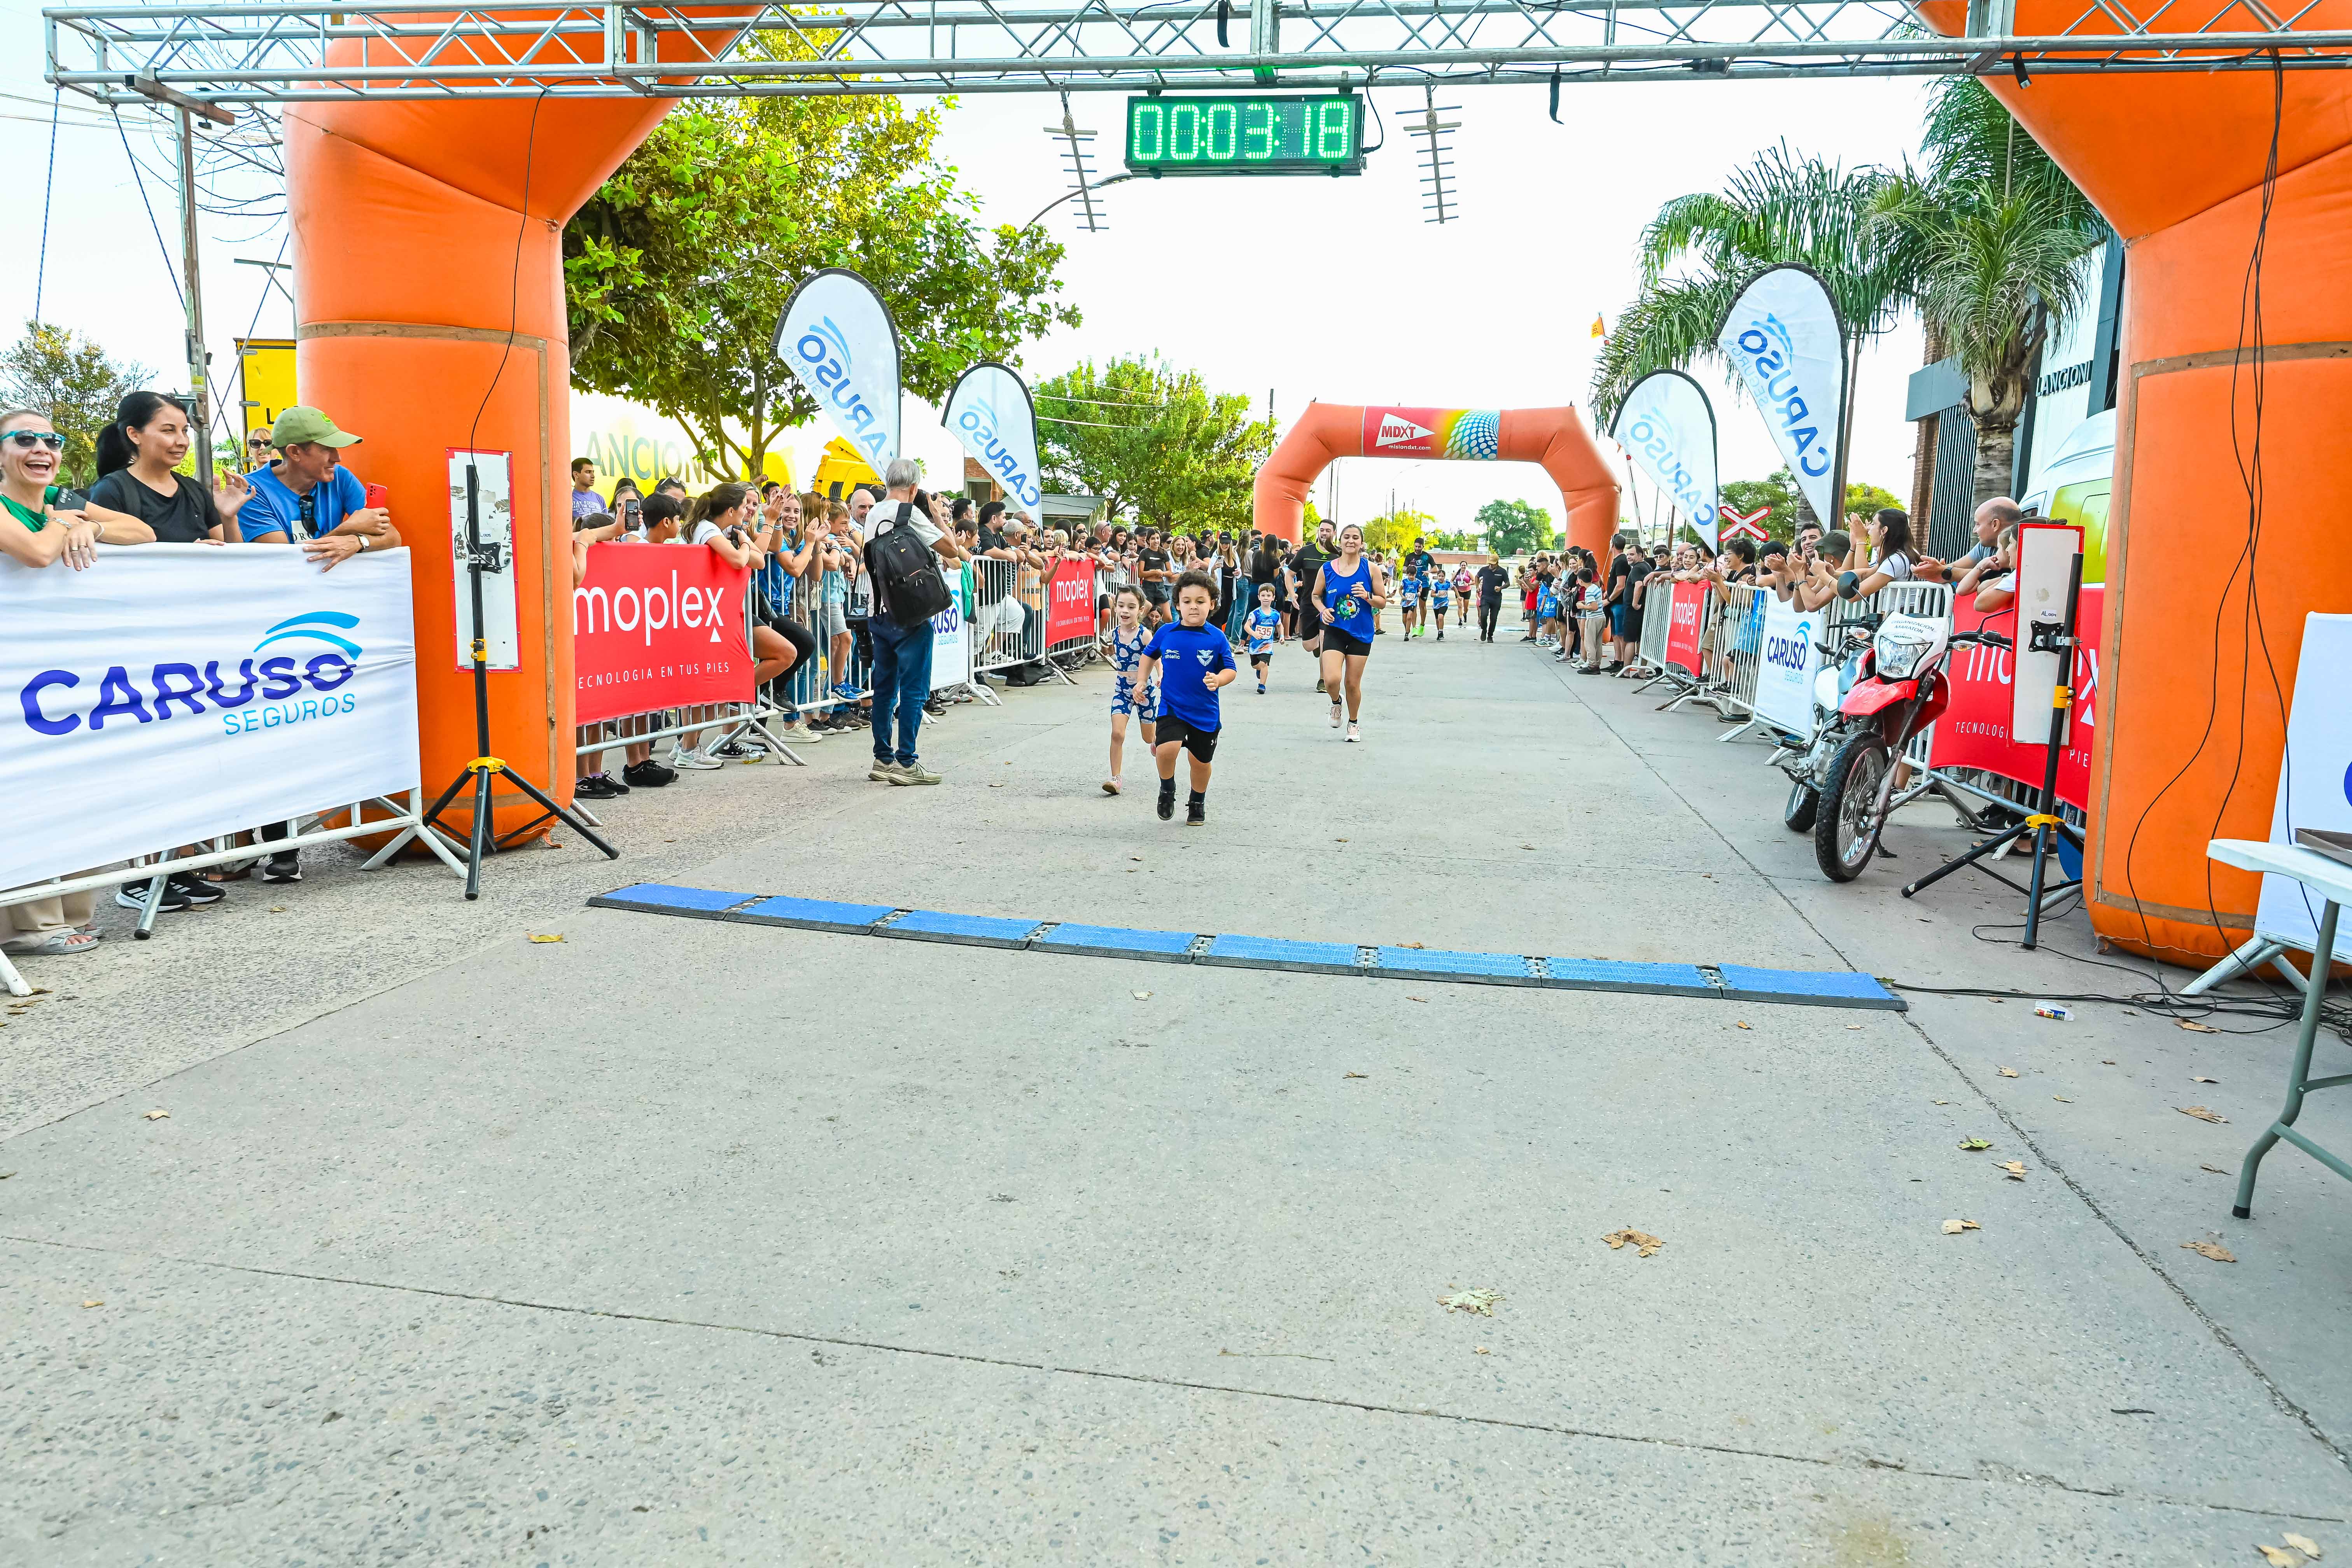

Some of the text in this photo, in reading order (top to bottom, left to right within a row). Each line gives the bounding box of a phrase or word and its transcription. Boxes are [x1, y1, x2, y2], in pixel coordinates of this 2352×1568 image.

[1133, 101, 1349, 159] 00:03:18
[2035, 360, 2094, 397] LANCIONI
[1381, 422, 1416, 439] MDXT
[585, 431, 709, 484] ANCIONI
[1056, 571, 1089, 609] moplex
[574, 570, 724, 646] moplex
[1673, 594, 1698, 632] moplex
[938, 635, 958, 645] SEGUROS
[1256, 626, 1272, 636] 535
[1892, 620, 1934, 631] ORGANIZACION
[1894, 625, 1923, 633] MARATON
[1768, 636, 1806, 670] CARUSO
[579, 662, 730, 689] ECNOLOGIA EN TUS PIES
[21, 654, 357, 735] CARUSO
[835, 687, 846, 696] FILA
[223, 693, 355, 735] SEGUROS
[1955, 722, 2009, 739] TECNOLOGI
[2069, 749, 2089, 767] PIE
